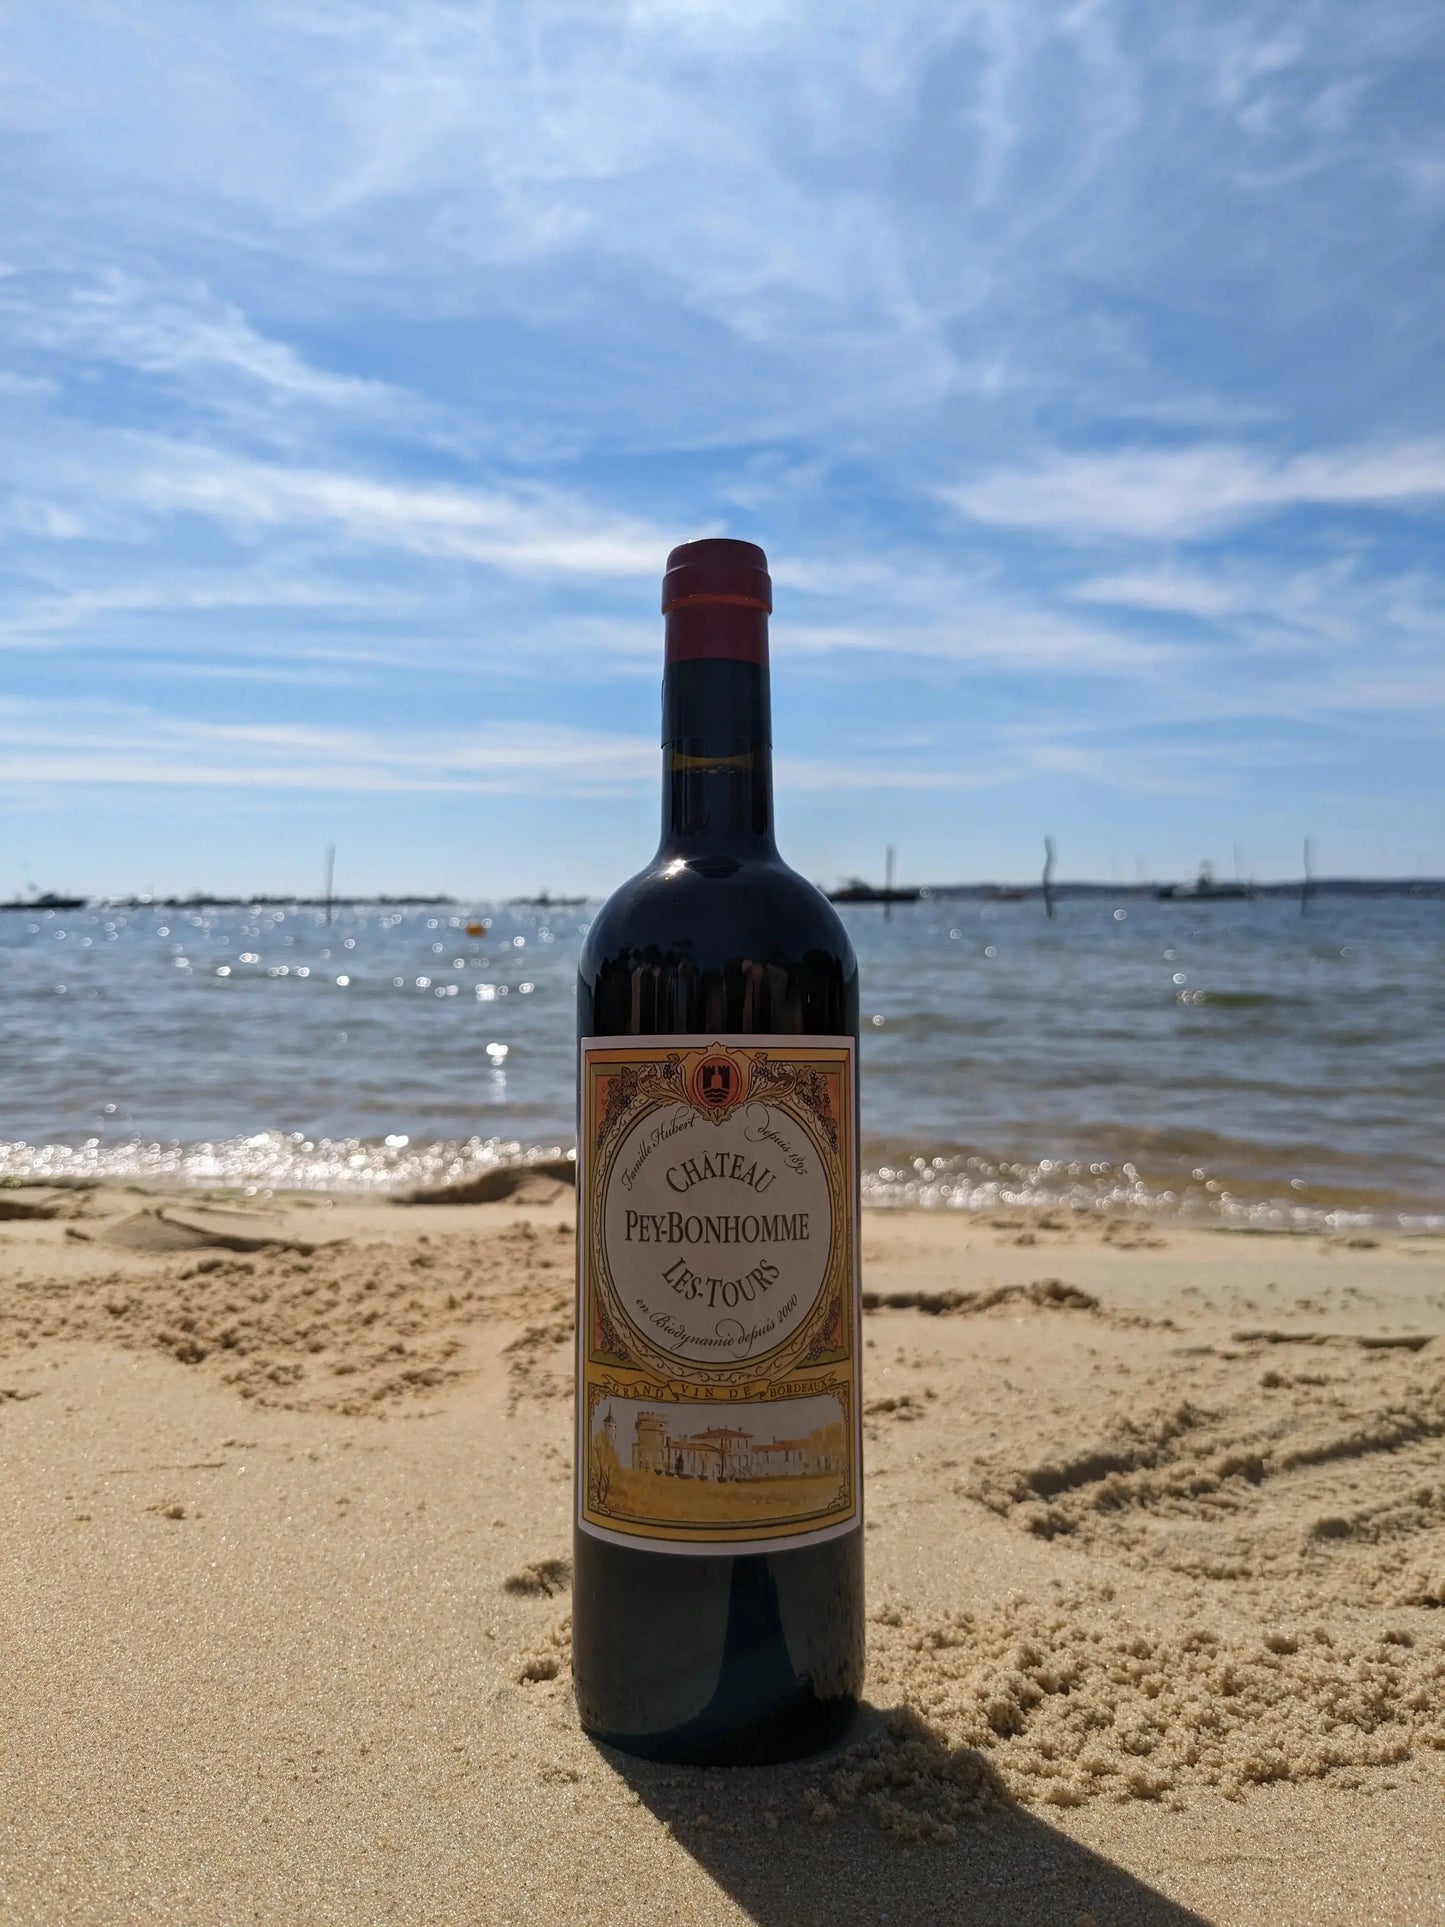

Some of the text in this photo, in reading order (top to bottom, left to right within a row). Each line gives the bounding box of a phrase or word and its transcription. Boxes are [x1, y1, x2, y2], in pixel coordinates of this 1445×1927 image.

[621, 1106, 702, 1191] Famille Hubert
[744, 1103, 808, 1175] depuis 1895
[665, 1150, 777, 1193] CHÂTEAU
[624, 1209, 810, 1244] PEY-BONHOMME
[661, 1256, 780, 1308] LES-TOURS
[636, 1294, 799, 1359] en Biodynamie depuis 2000
[612, 1378, 828, 1399] GRAND VIN DE BORDEAUX
